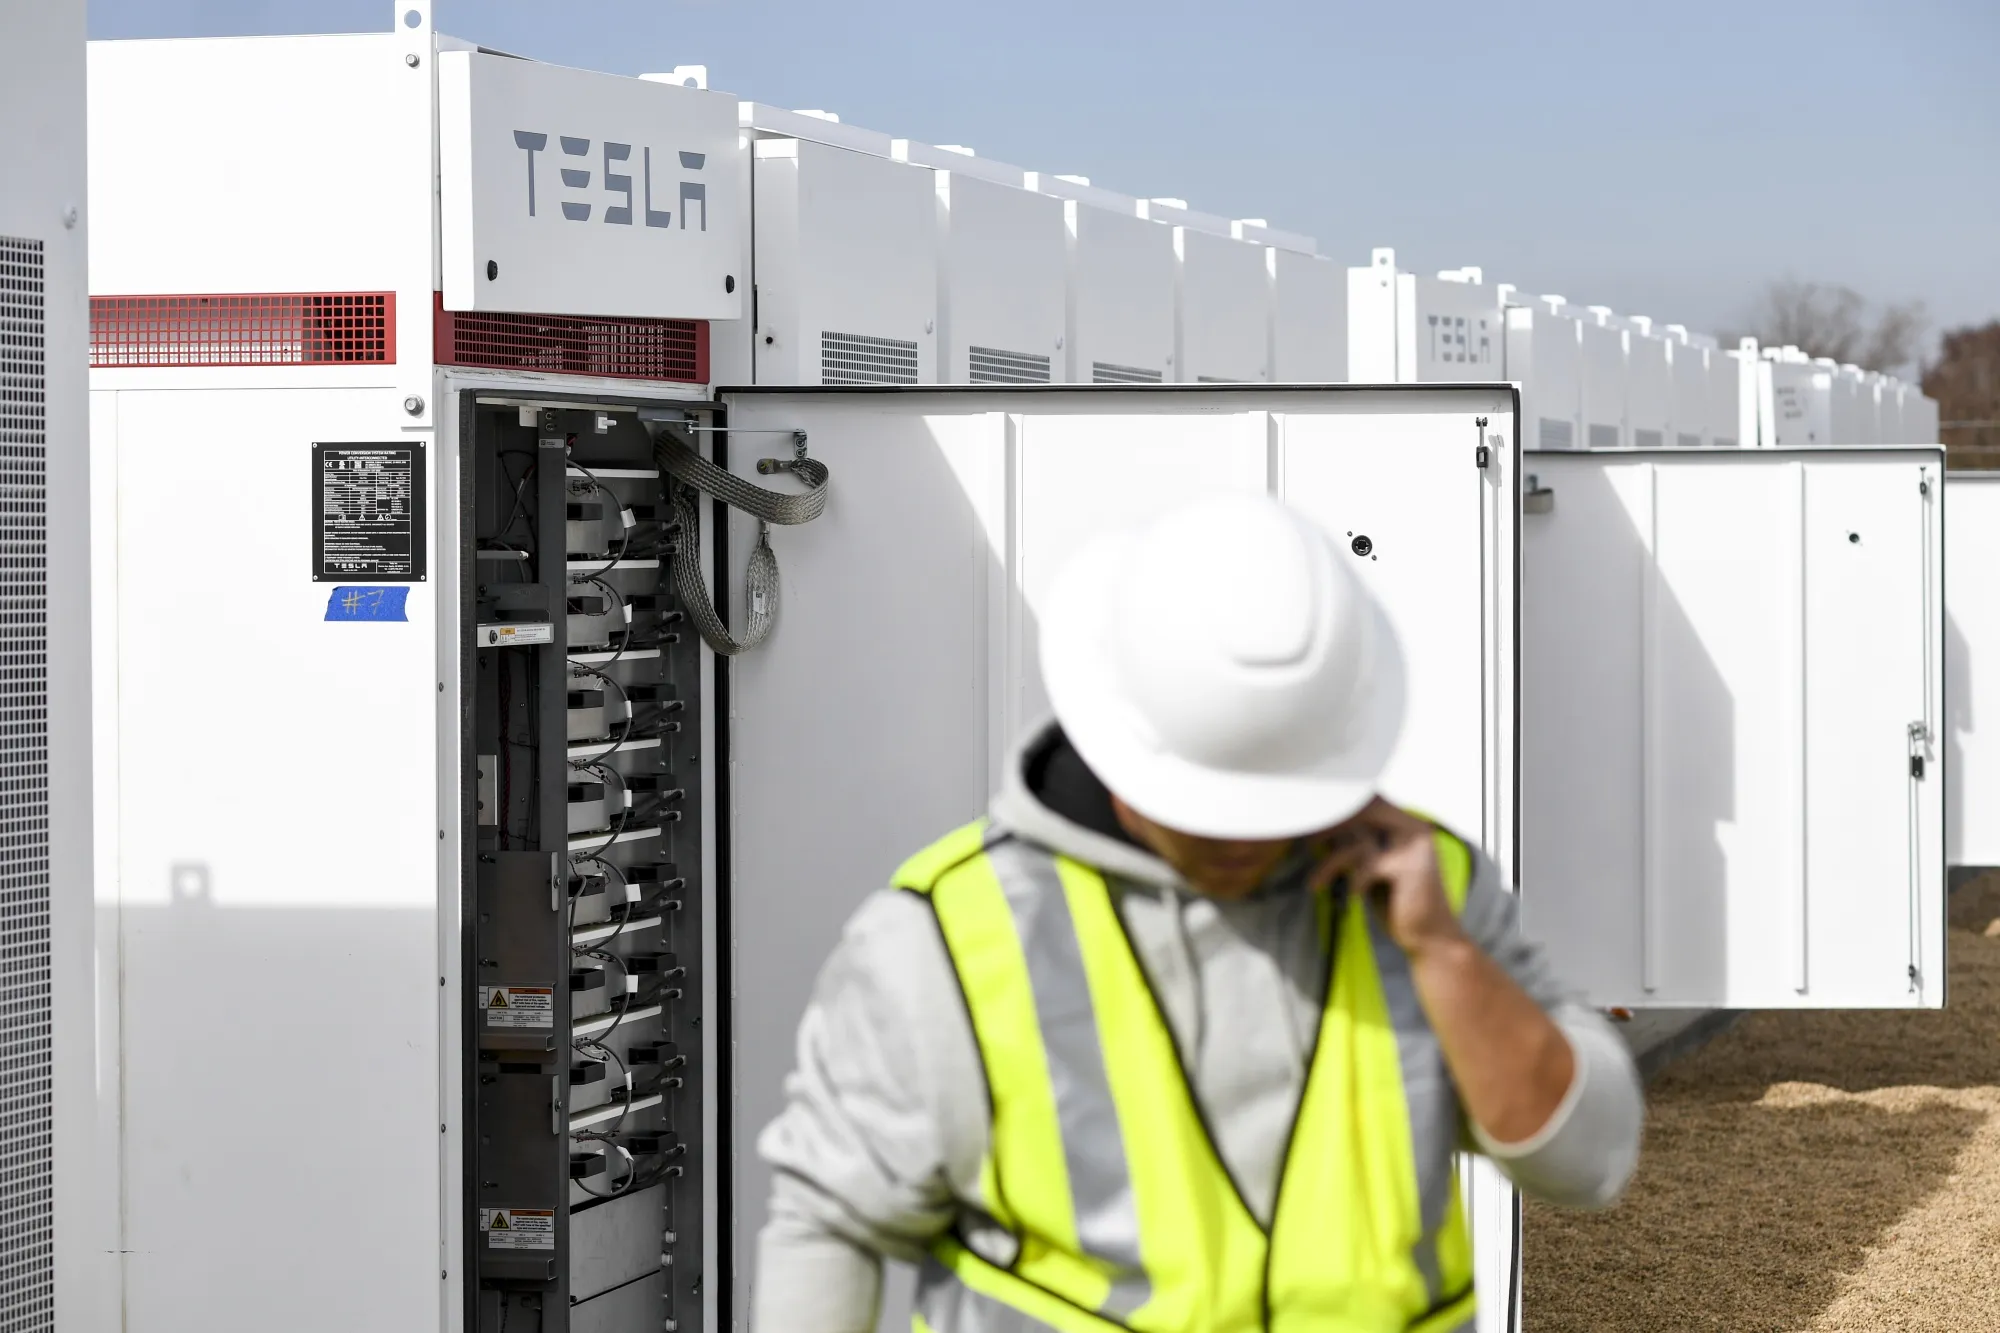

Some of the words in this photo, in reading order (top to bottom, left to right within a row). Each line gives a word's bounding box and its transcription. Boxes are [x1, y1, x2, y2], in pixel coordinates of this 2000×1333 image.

[513, 129, 706, 231] TESLA
[1427, 315, 1490, 364] TESLA
[341, 589, 384, 615] #7
